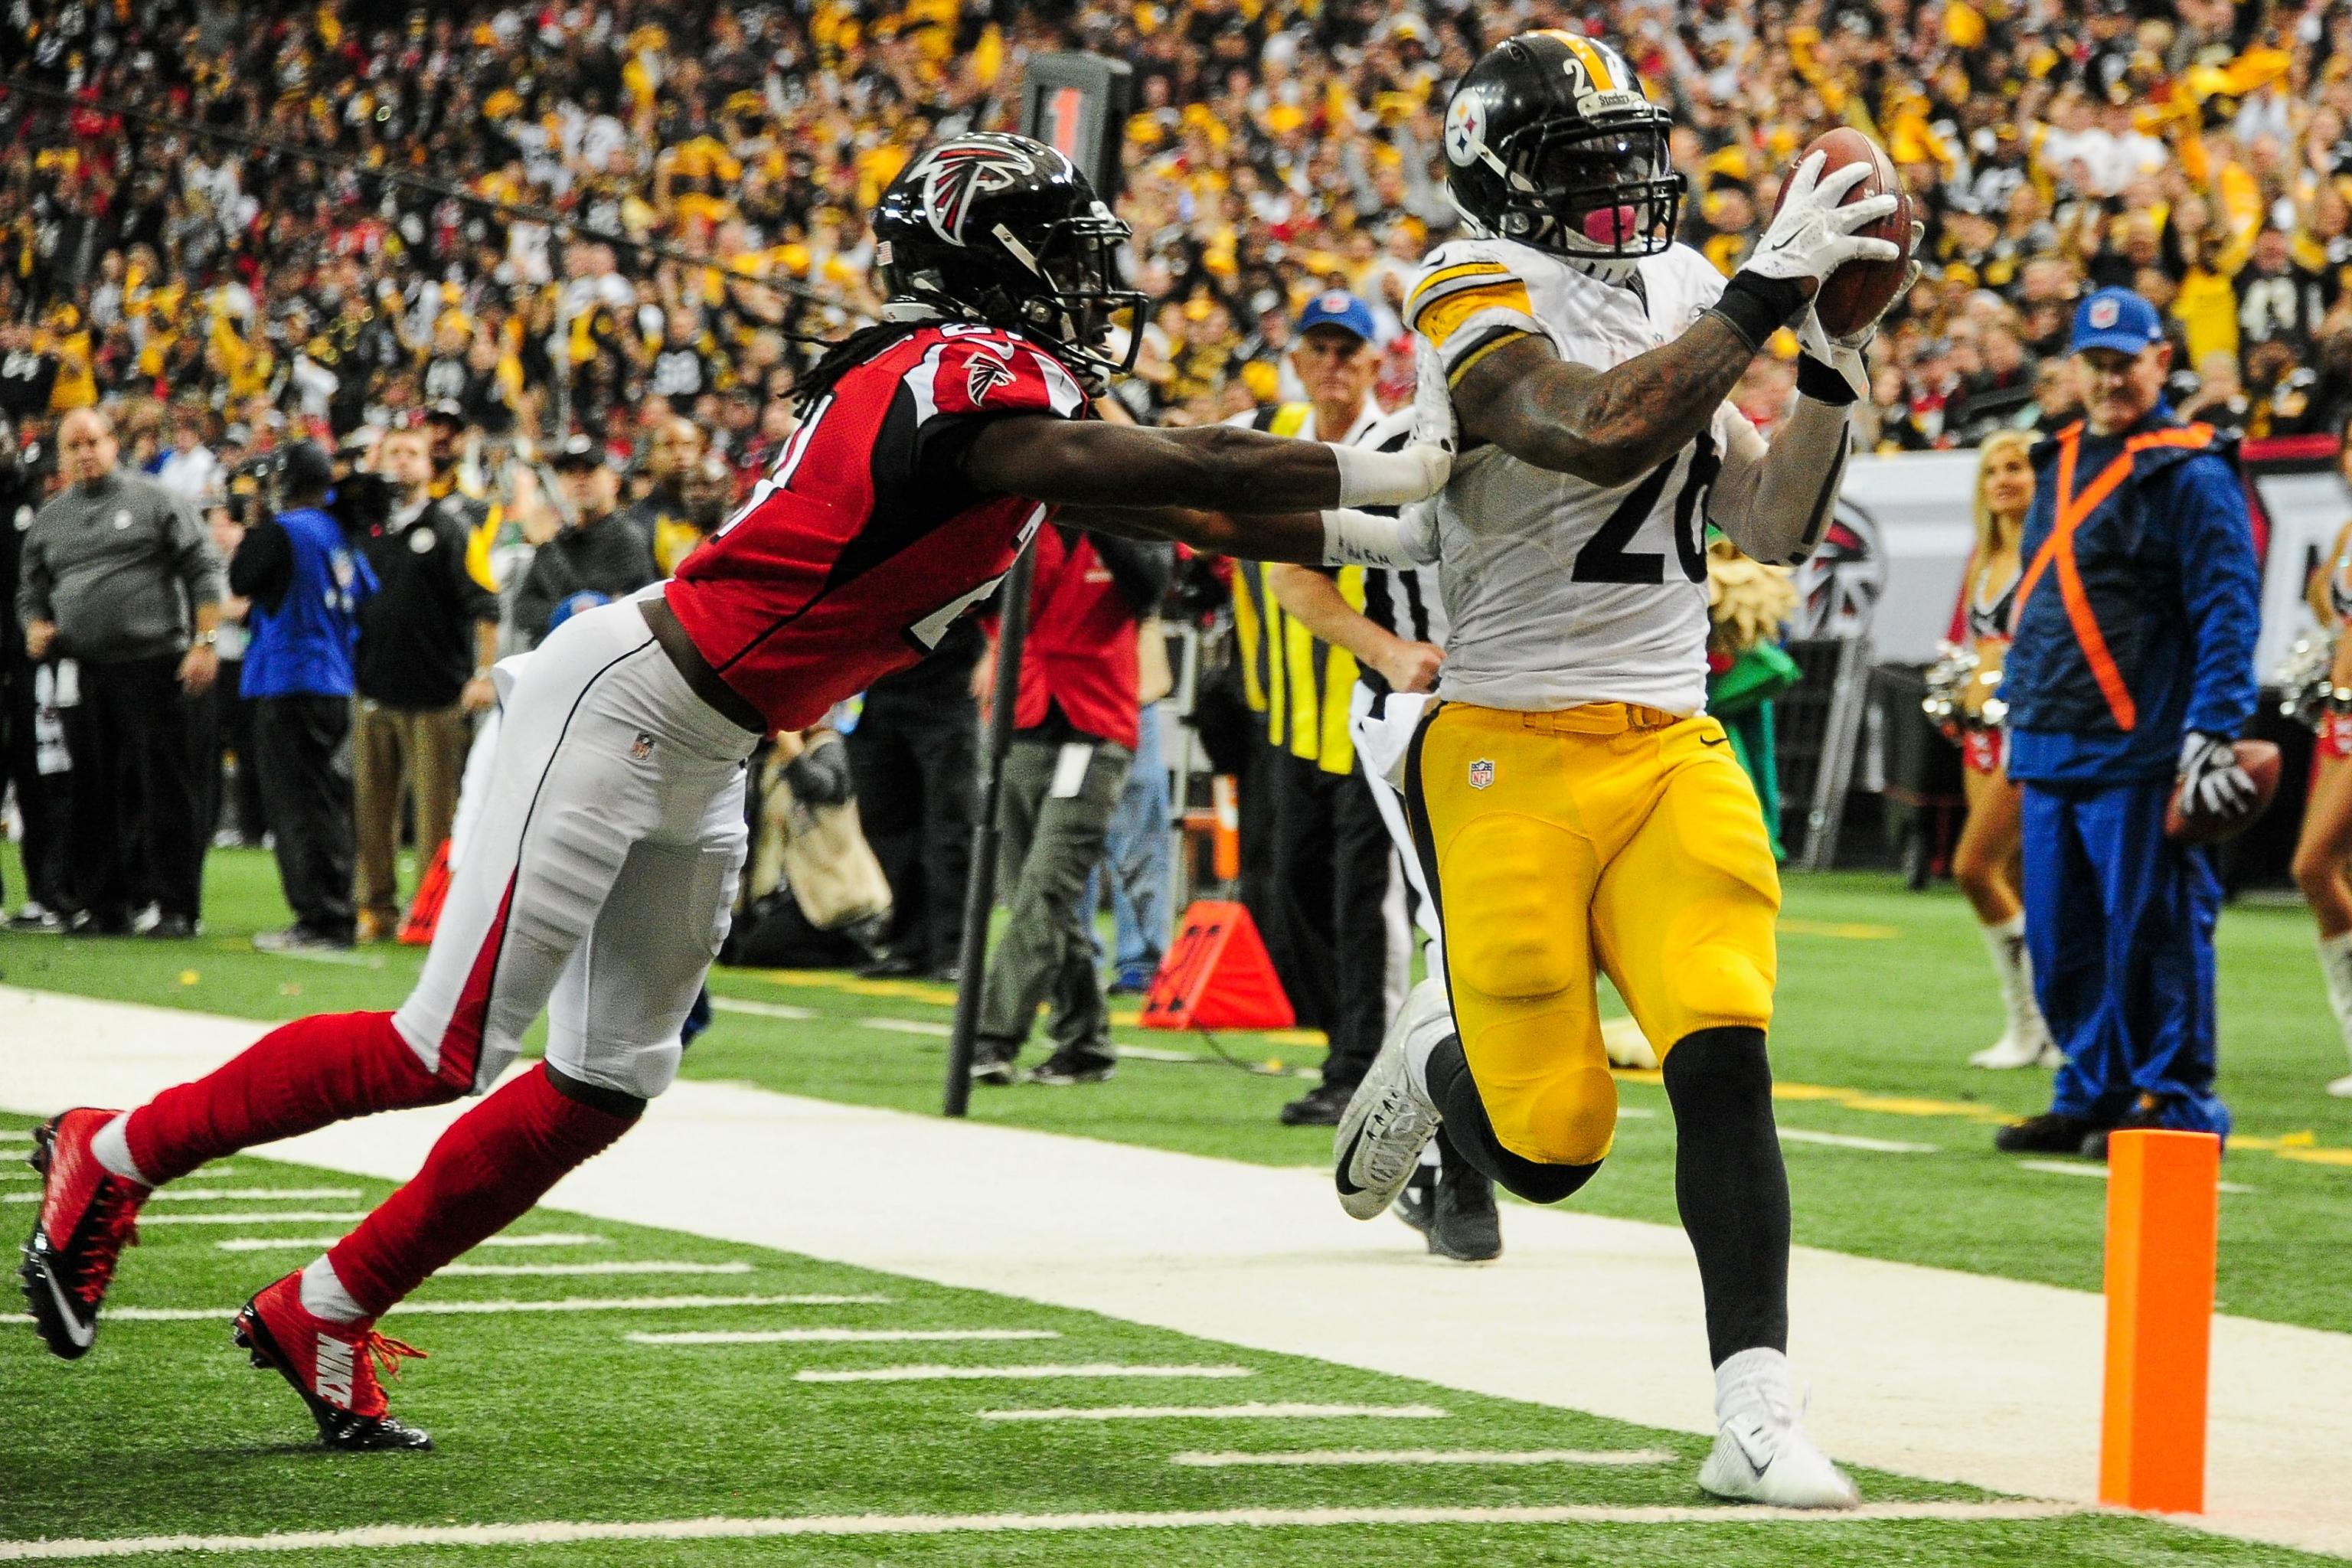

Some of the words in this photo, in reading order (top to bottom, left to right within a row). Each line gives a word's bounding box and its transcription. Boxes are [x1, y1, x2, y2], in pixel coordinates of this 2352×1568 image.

[1048, 86, 1082, 158] 1
[1472, 771, 1491, 785] NFL
[315, 1331, 354, 1410] NIKE
